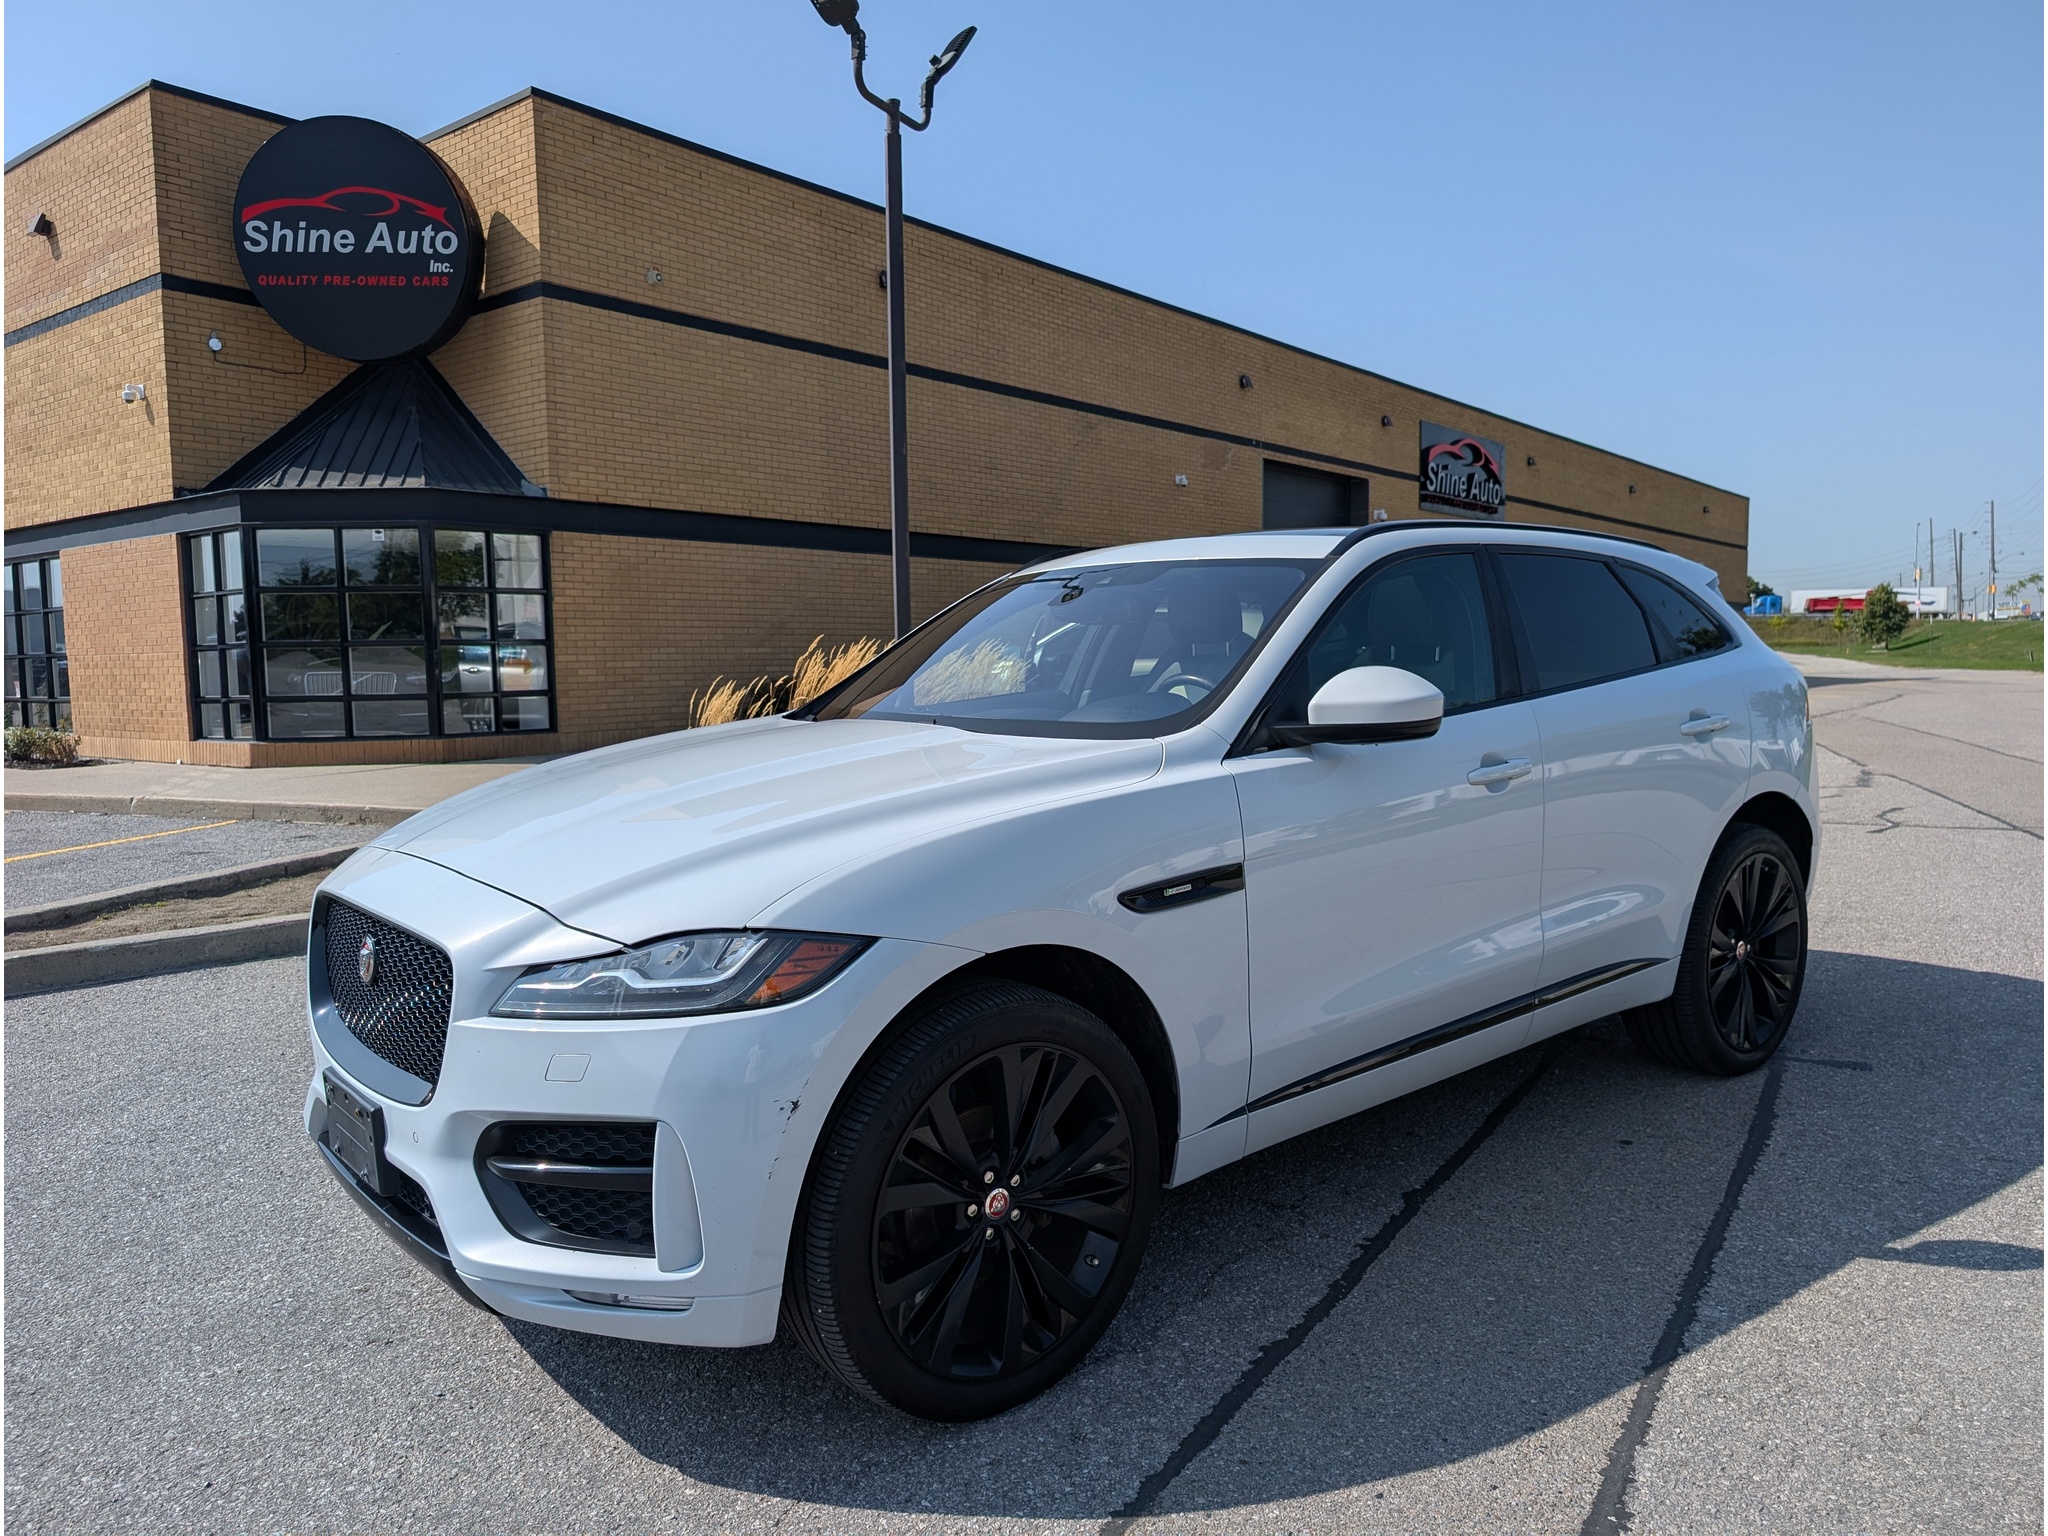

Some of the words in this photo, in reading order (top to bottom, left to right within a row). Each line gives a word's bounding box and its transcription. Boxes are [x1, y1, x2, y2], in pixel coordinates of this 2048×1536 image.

[243, 220, 355, 254] Shine
[365, 222, 459, 255] Auto
[258, 275, 318, 286] QUALITY
[323, 275, 407, 287] PRE-OWNED
[412, 276, 449, 287] CARS
[429, 259, 454, 273] Inc.
[1426, 462, 1468, 498] Shine
[1469, 472, 1501, 505] Auto
[889, 1034, 977, 1128] MICHELIN
